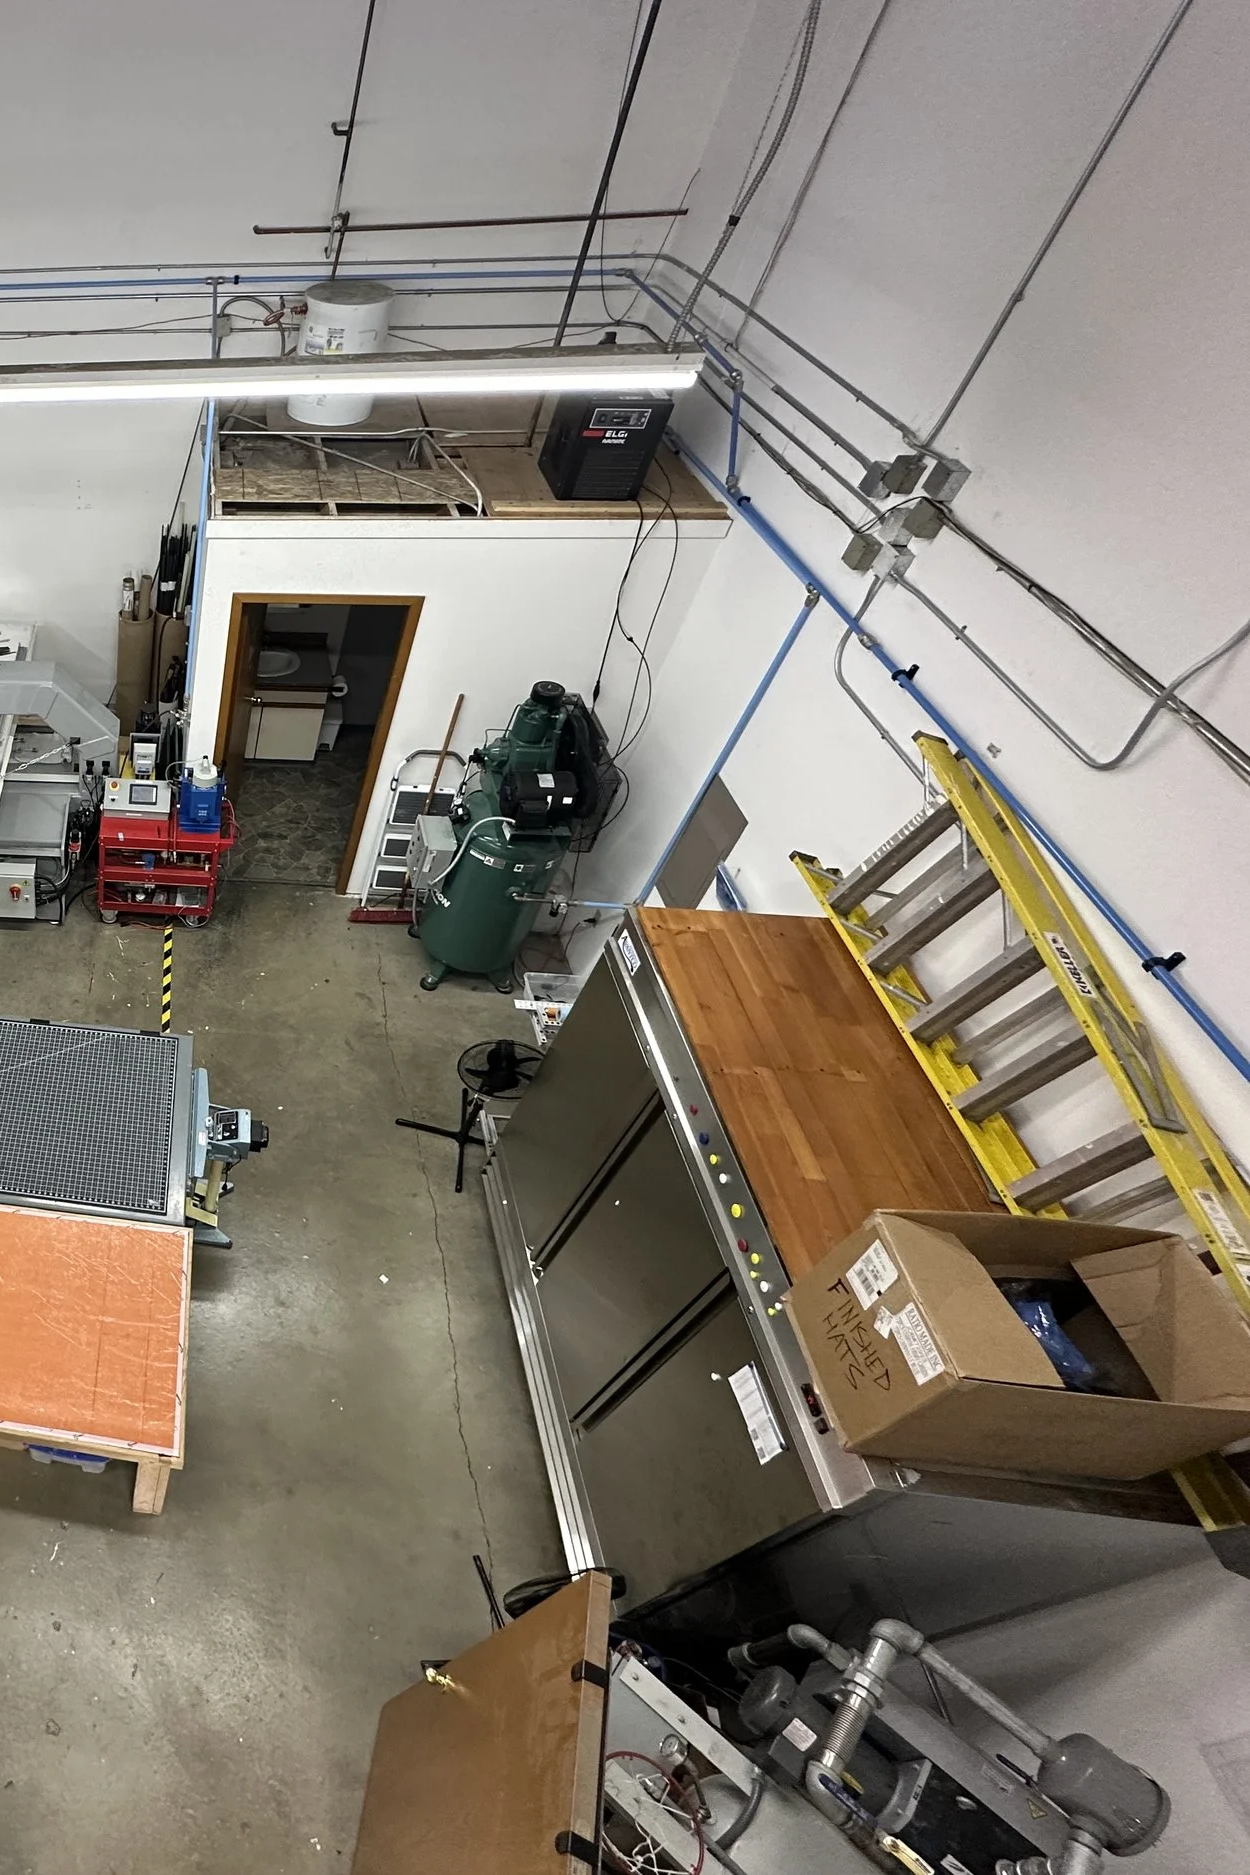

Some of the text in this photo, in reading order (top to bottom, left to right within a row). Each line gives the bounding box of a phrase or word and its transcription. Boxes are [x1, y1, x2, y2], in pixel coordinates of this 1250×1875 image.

[822, 1311, 865, 1390] HATS
[827, 1277, 891, 1391] FINISHED
[906, 1307, 924, 1333] RATIO
[917, 1329, 935, 1356] MADE
[928, 1352, 943, 1371] INC
